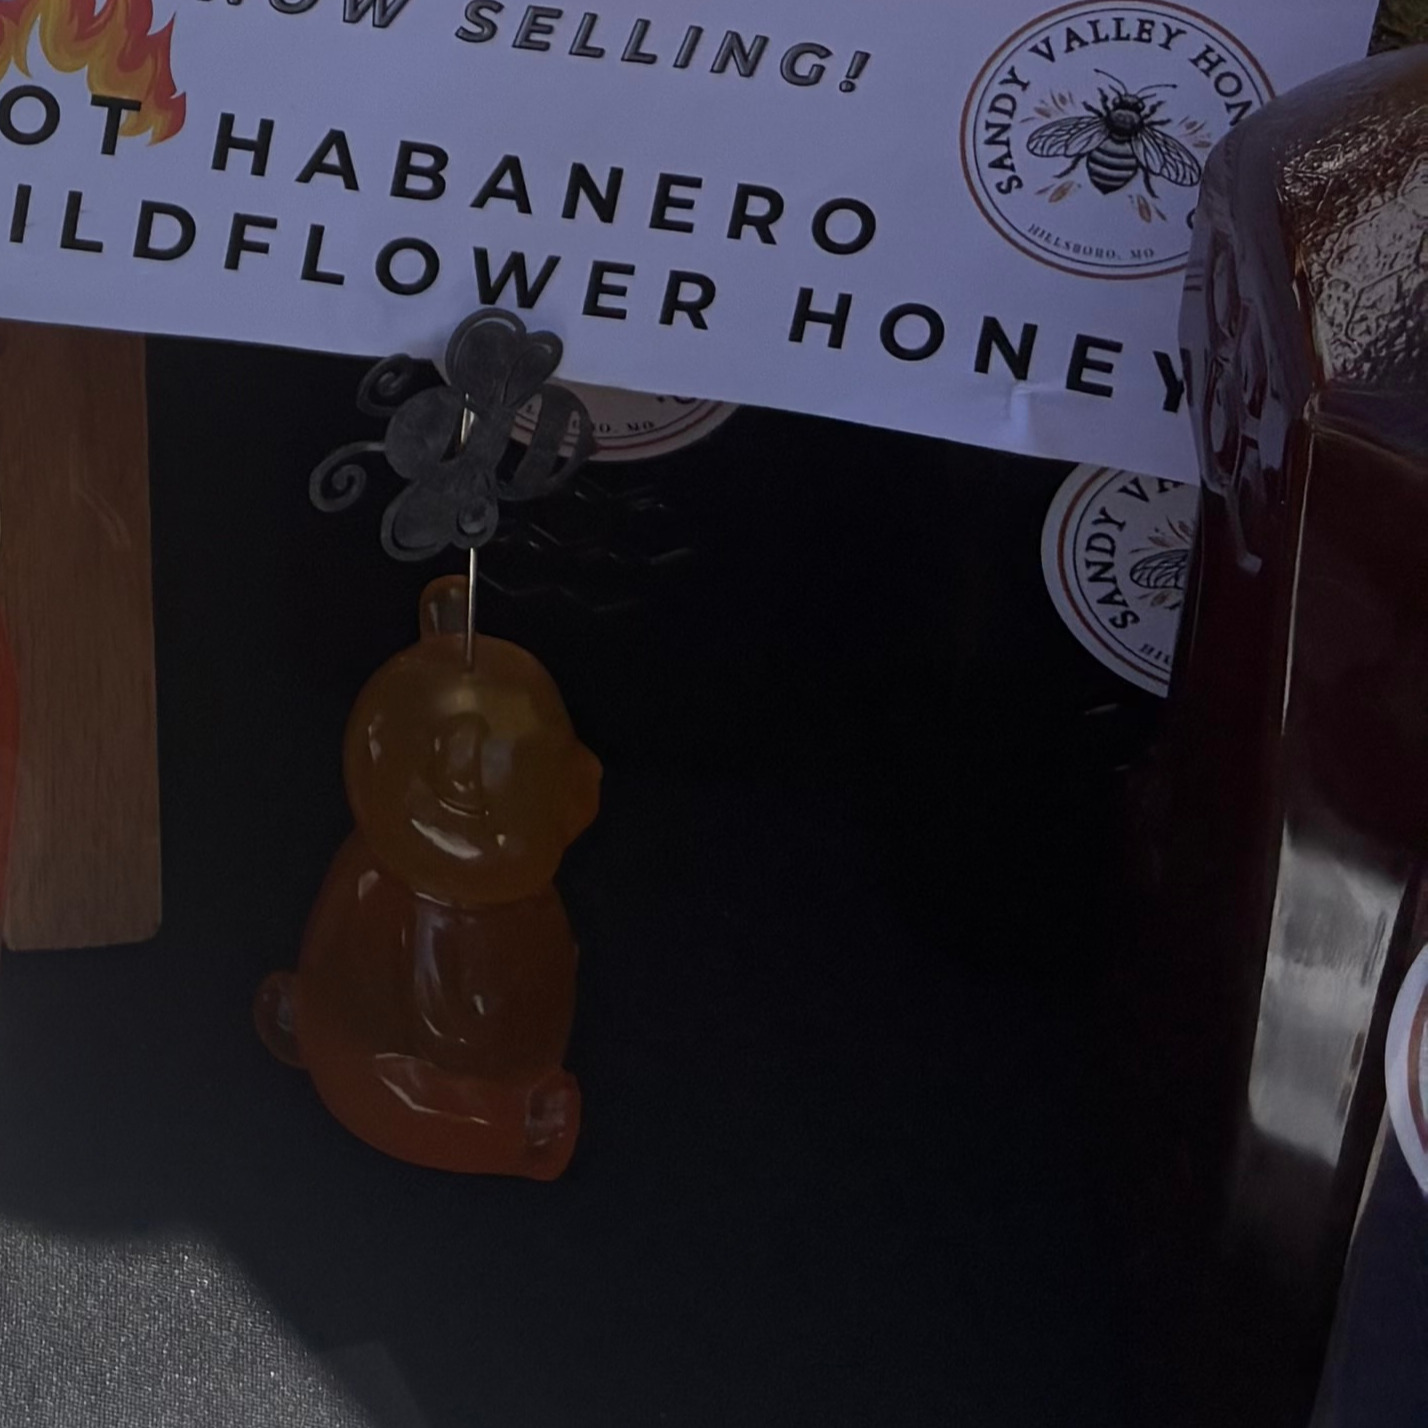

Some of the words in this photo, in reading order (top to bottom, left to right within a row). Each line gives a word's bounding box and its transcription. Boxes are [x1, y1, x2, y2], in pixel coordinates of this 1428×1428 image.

[983, 65, 1031, 195] SANDY
[1028, 16, 1187, 64] VALLEY
[1188, 44, 1255, 127] HON
[209, 111, 879, 258] HABANERO
[1026, 222, 1122, 260] HILLSBORO,
[1130, 248, 1156, 260] MO
[788, 286, 1187, 416] HONEY
[1085, 506, 1141, 630] SANDY
